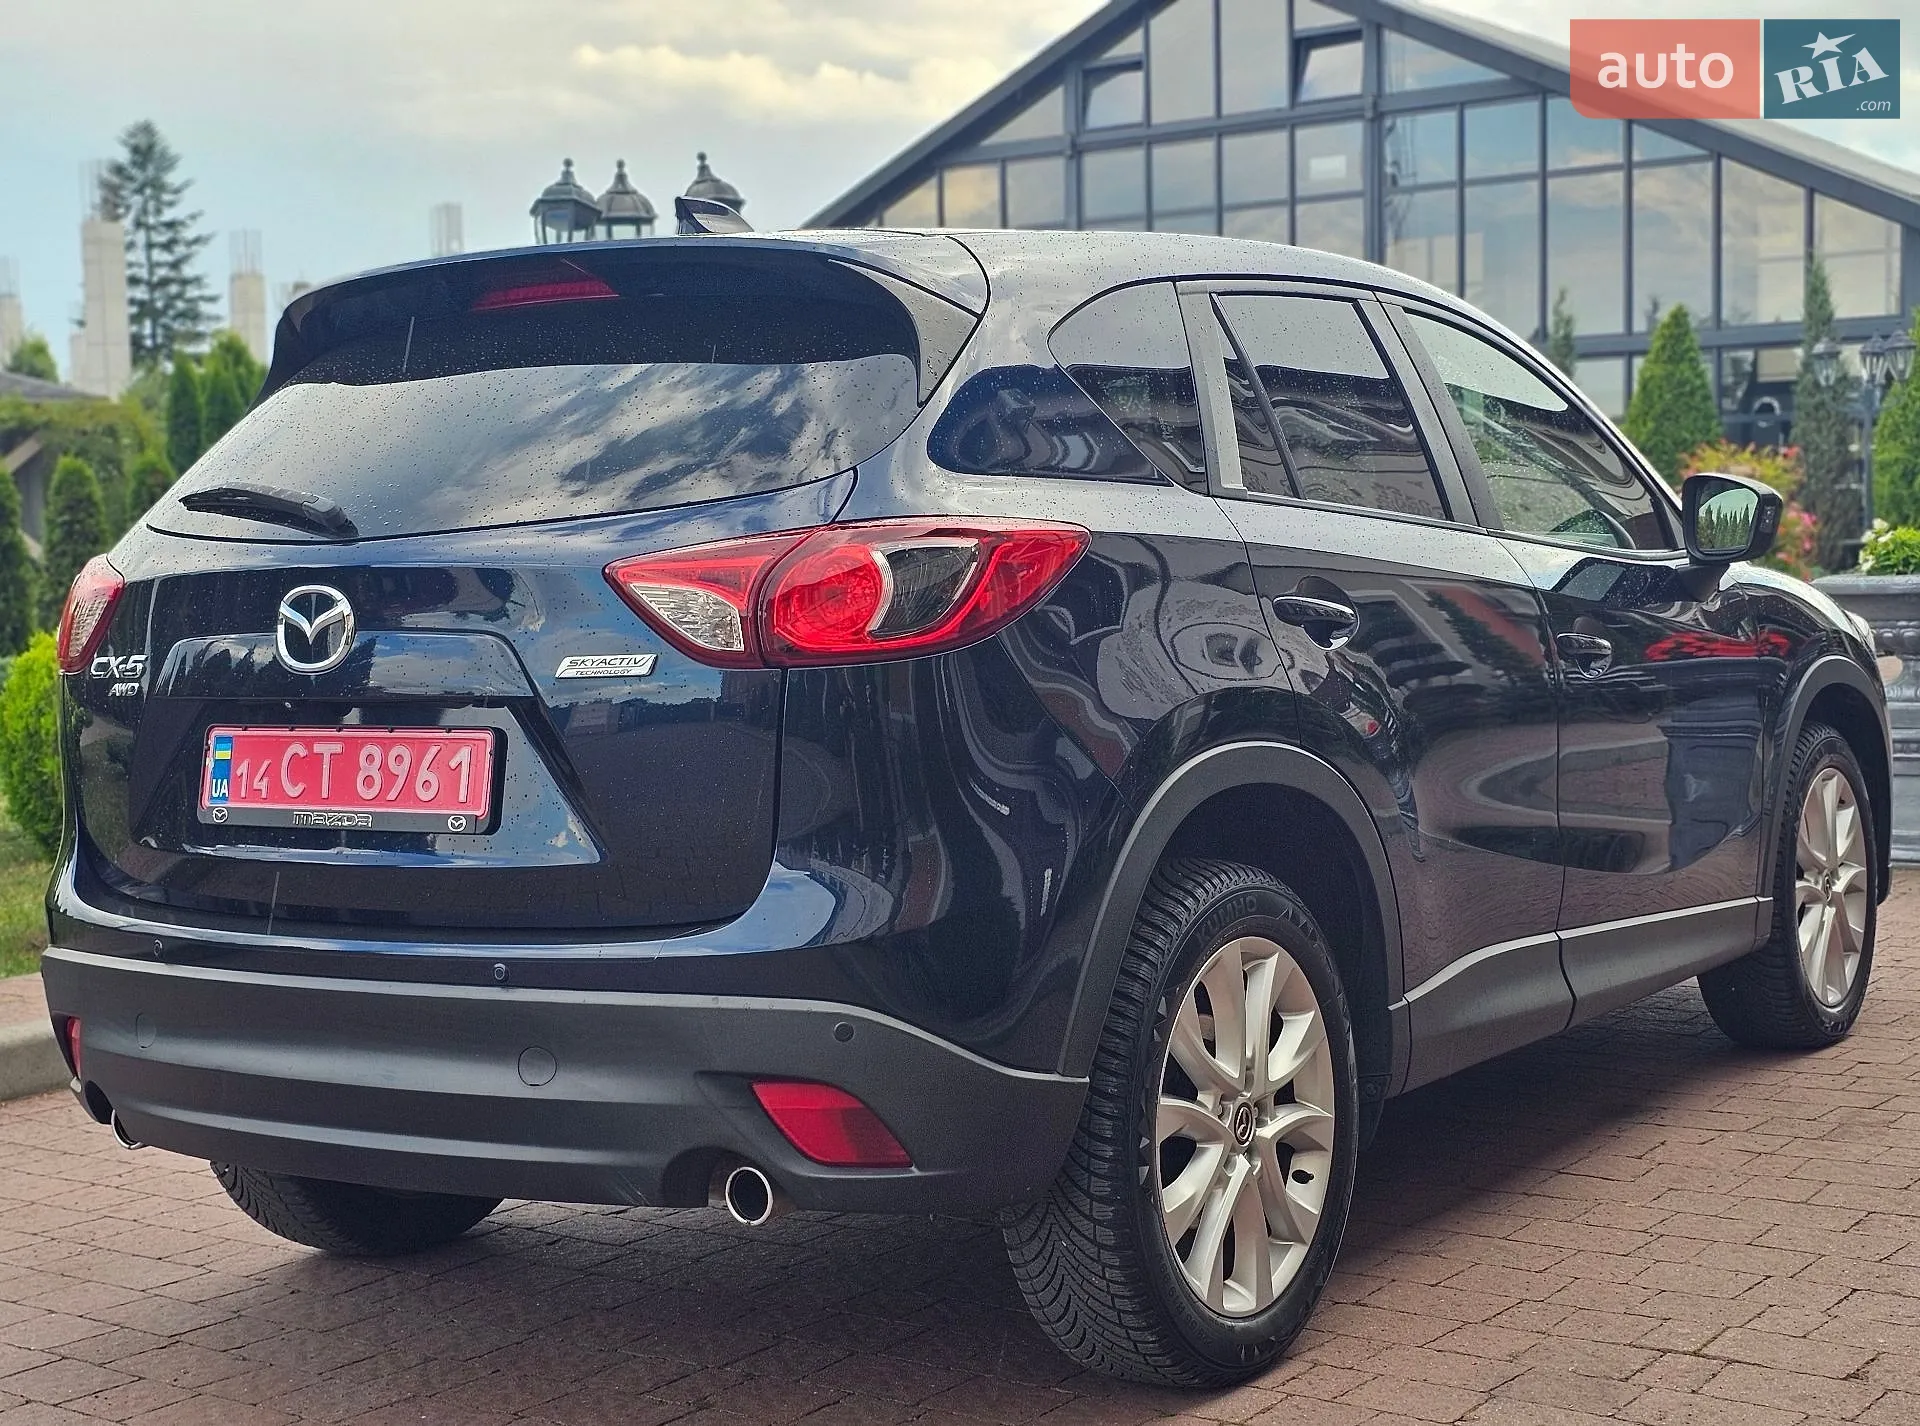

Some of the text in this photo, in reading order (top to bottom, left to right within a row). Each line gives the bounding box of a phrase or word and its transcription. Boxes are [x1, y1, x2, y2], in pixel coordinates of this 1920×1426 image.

[91, 655, 147, 679] CX-5
[566, 656, 646, 668] SKYACTIV
[575, 668, 633, 676] TECHNOLOGY
[107, 682, 140, 697] AWD
[235, 741, 474, 804] 14 CT 8961
[211, 778, 229, 798] UA
